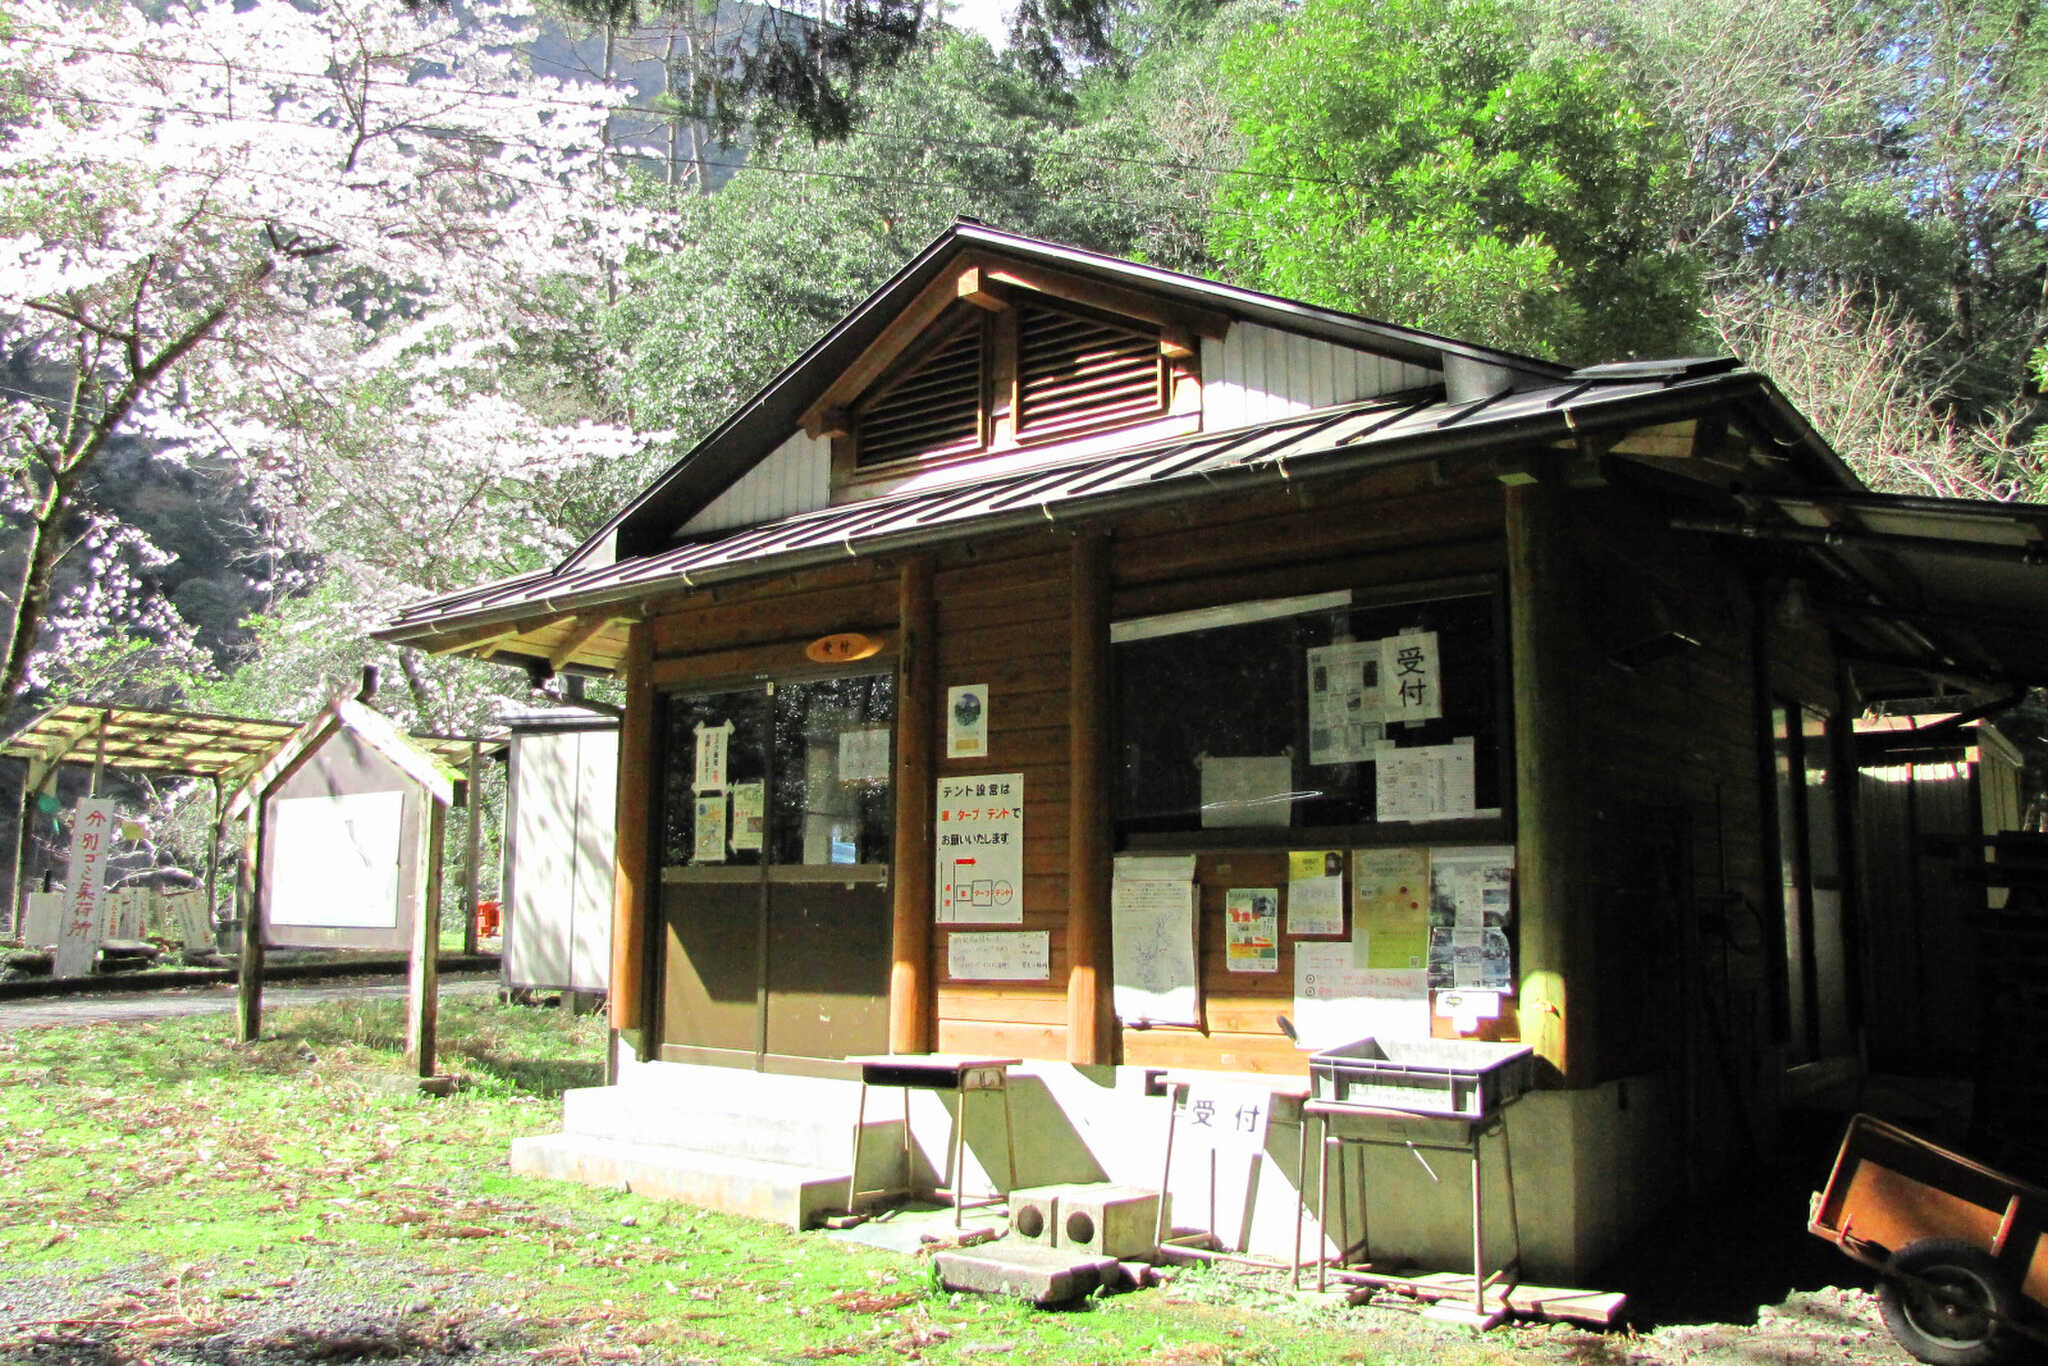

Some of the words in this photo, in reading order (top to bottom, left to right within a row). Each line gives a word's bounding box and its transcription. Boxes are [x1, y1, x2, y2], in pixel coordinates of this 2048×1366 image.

[1397, 646, 1427, 707] 受付
[943, 784, 1010, 798] テント設営は
[941, 833, 1009, 846] お願いいたします
[1191, 1099, 1261, 1133] 受付
